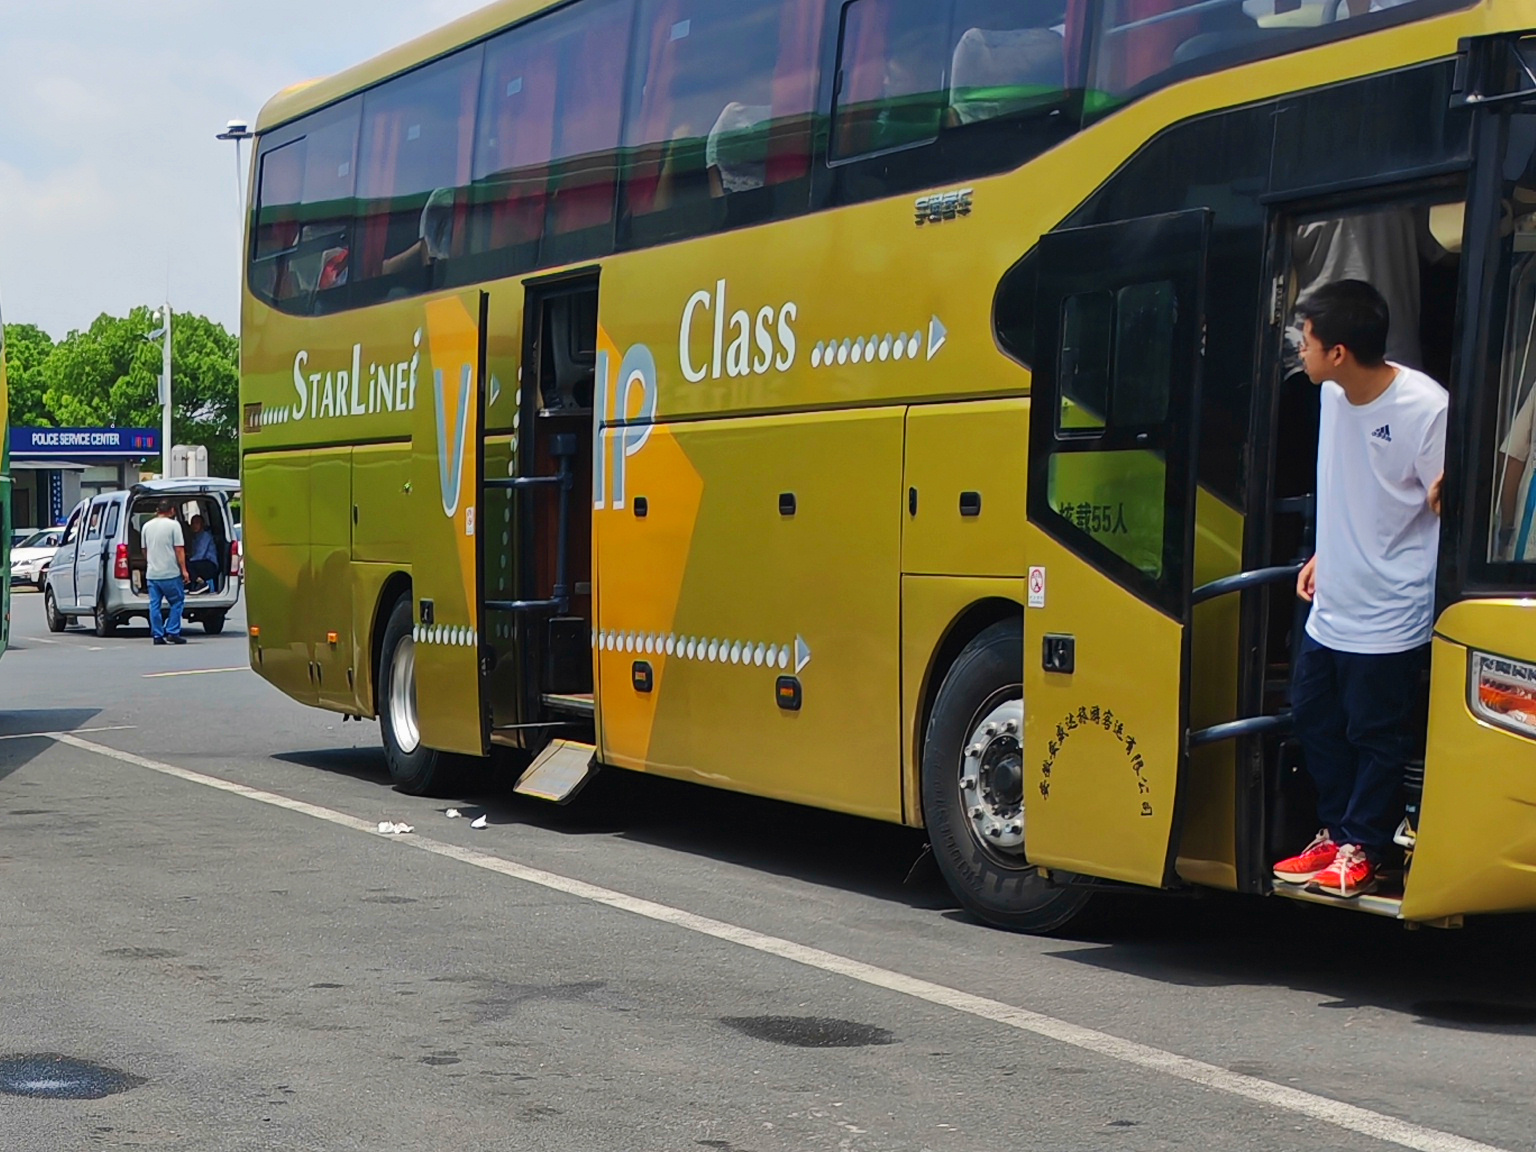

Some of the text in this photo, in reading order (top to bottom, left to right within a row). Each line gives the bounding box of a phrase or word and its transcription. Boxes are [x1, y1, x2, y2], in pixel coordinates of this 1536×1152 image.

[679, 278, 797, 383] Class
[31, 432, 59, 446] POLICE
[59, 432, 90, 446] SERVICE
[90, 432, 120, 446] CENTER
